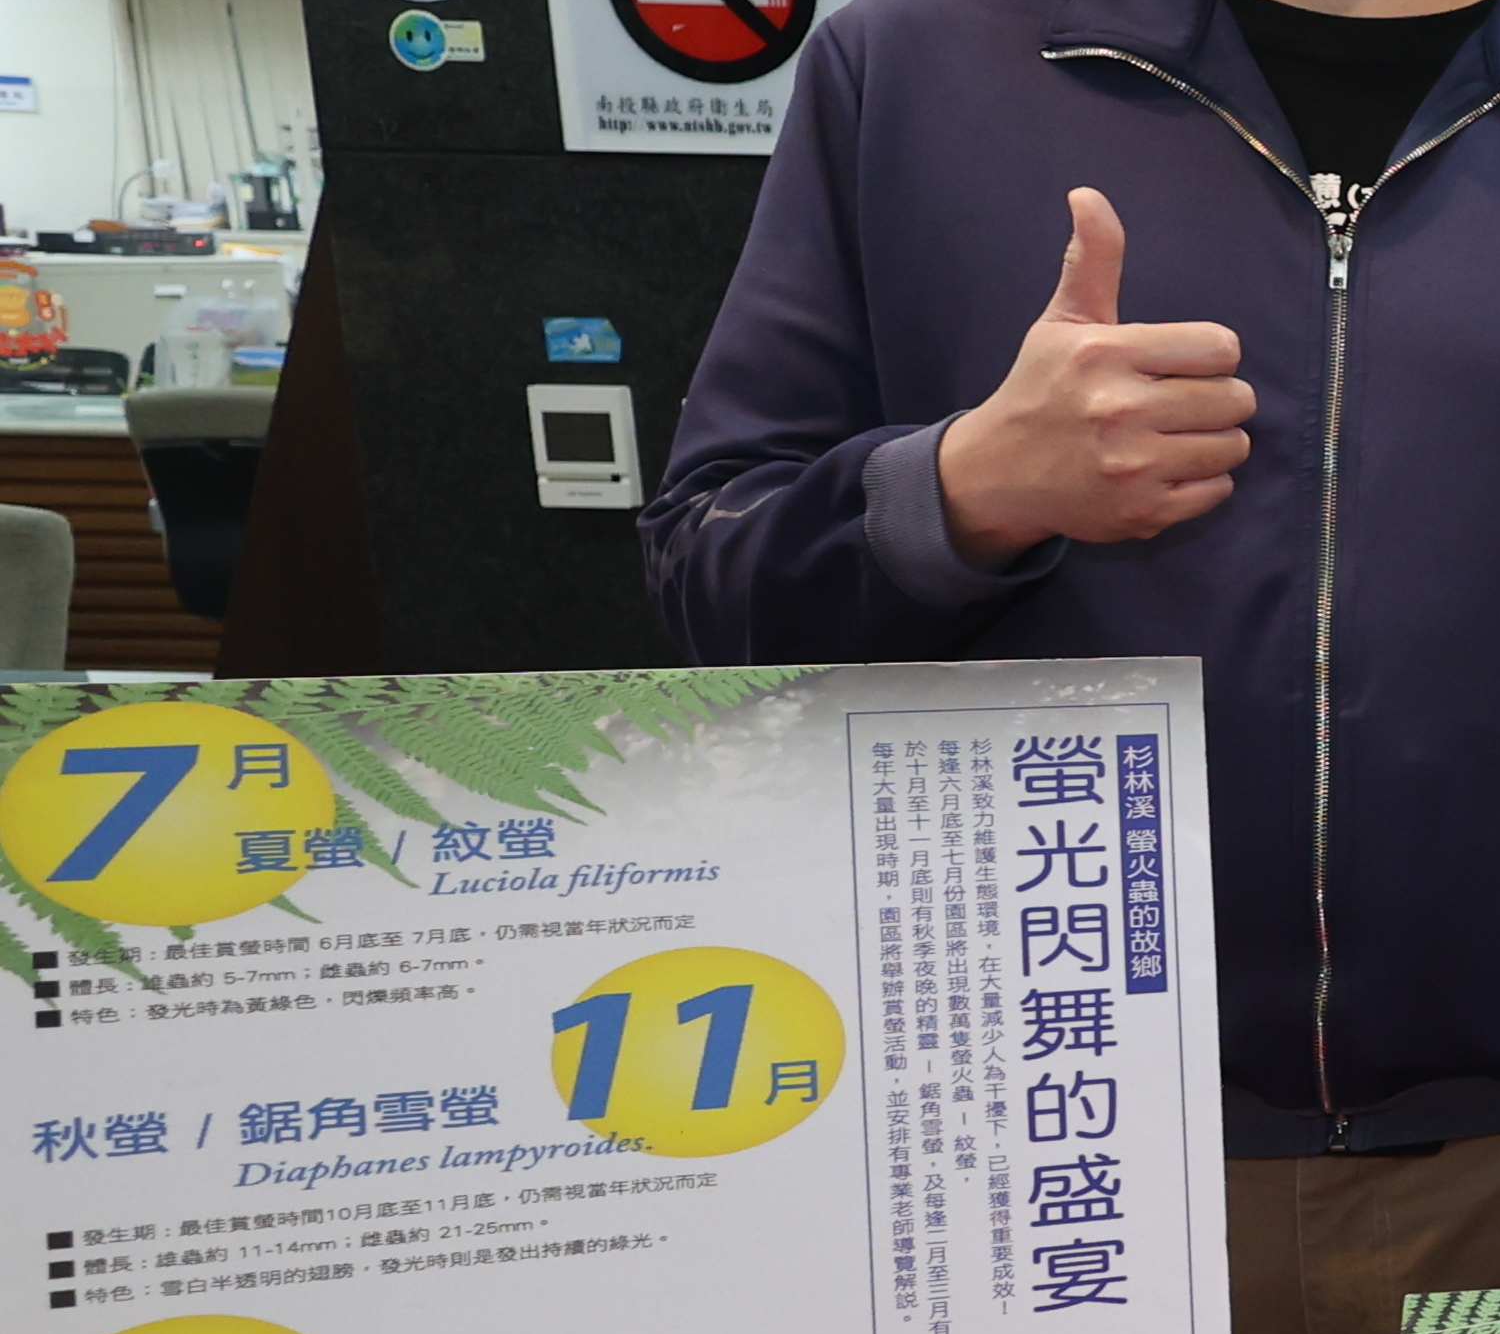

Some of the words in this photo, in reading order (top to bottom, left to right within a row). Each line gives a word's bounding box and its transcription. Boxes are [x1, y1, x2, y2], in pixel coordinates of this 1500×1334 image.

[1122, 744, 1157, 820] 杉林溪
[234, 826, 365, 875] 夏螢
[431, 817, 557, 864] 紋螢
[429, 867, 559, 896] Luciola
[558, 859, 722, 898] filiformis
[1124, 828, 1163, 980] 螢火蟲的故鄉
[1011, 733, 1128, 1313] 螢光閃舞的盛宴
[31, 1111, 169, 1164] 秋螢
[238, 1085, 501, 1147] 鋸角雪螢
[233, 1149, 431, 1190] Diaphanes
[437, 1135, 655, 1177] lampyroides.
